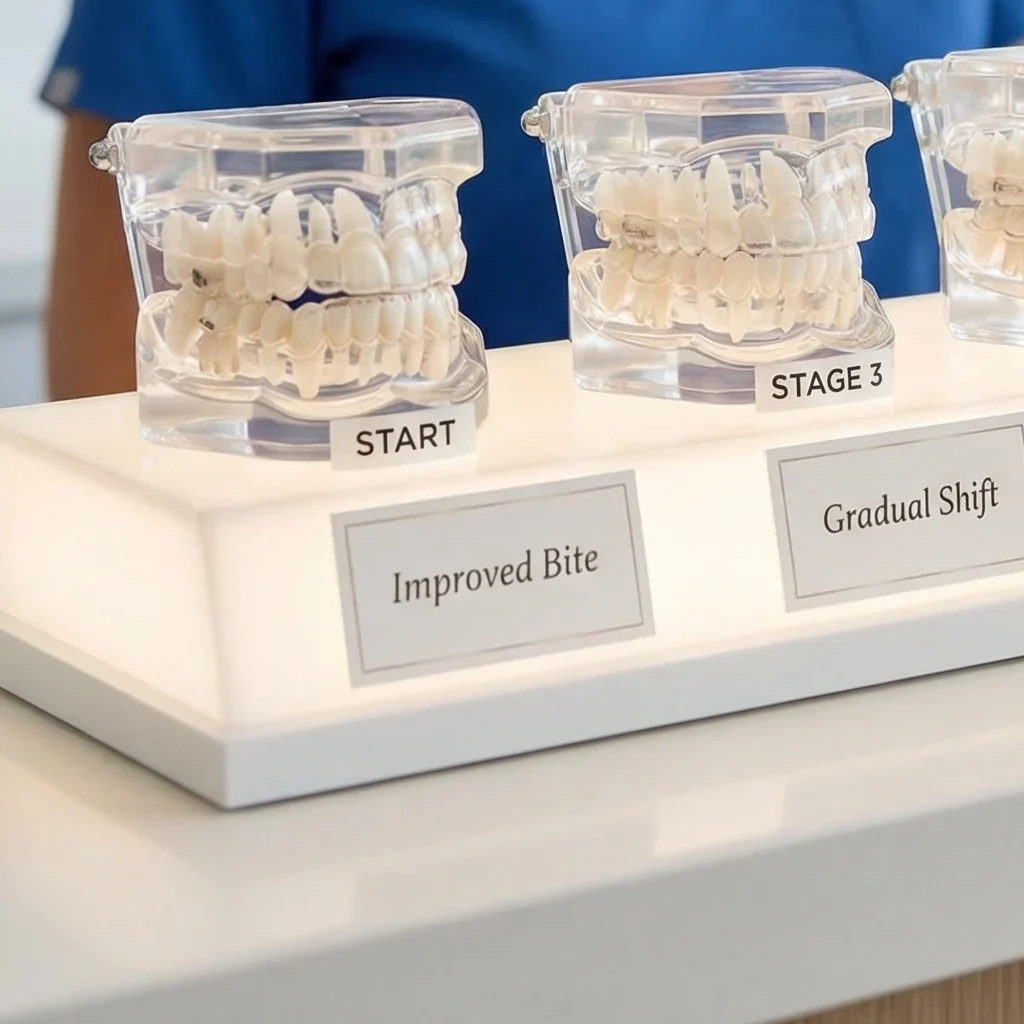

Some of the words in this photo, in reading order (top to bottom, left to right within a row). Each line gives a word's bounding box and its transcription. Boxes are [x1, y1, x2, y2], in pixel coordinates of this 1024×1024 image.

[771, 365, 862, 400] STAGE
[869, 362, 884, 387] 3
[356, 419, 456, 457] START
[823, 487, 931, 534] Gradual
[939, 477, 999, 519] Shift
[392, 549, 533, 607] Improved
[543, 545, 599, 580] Bite
